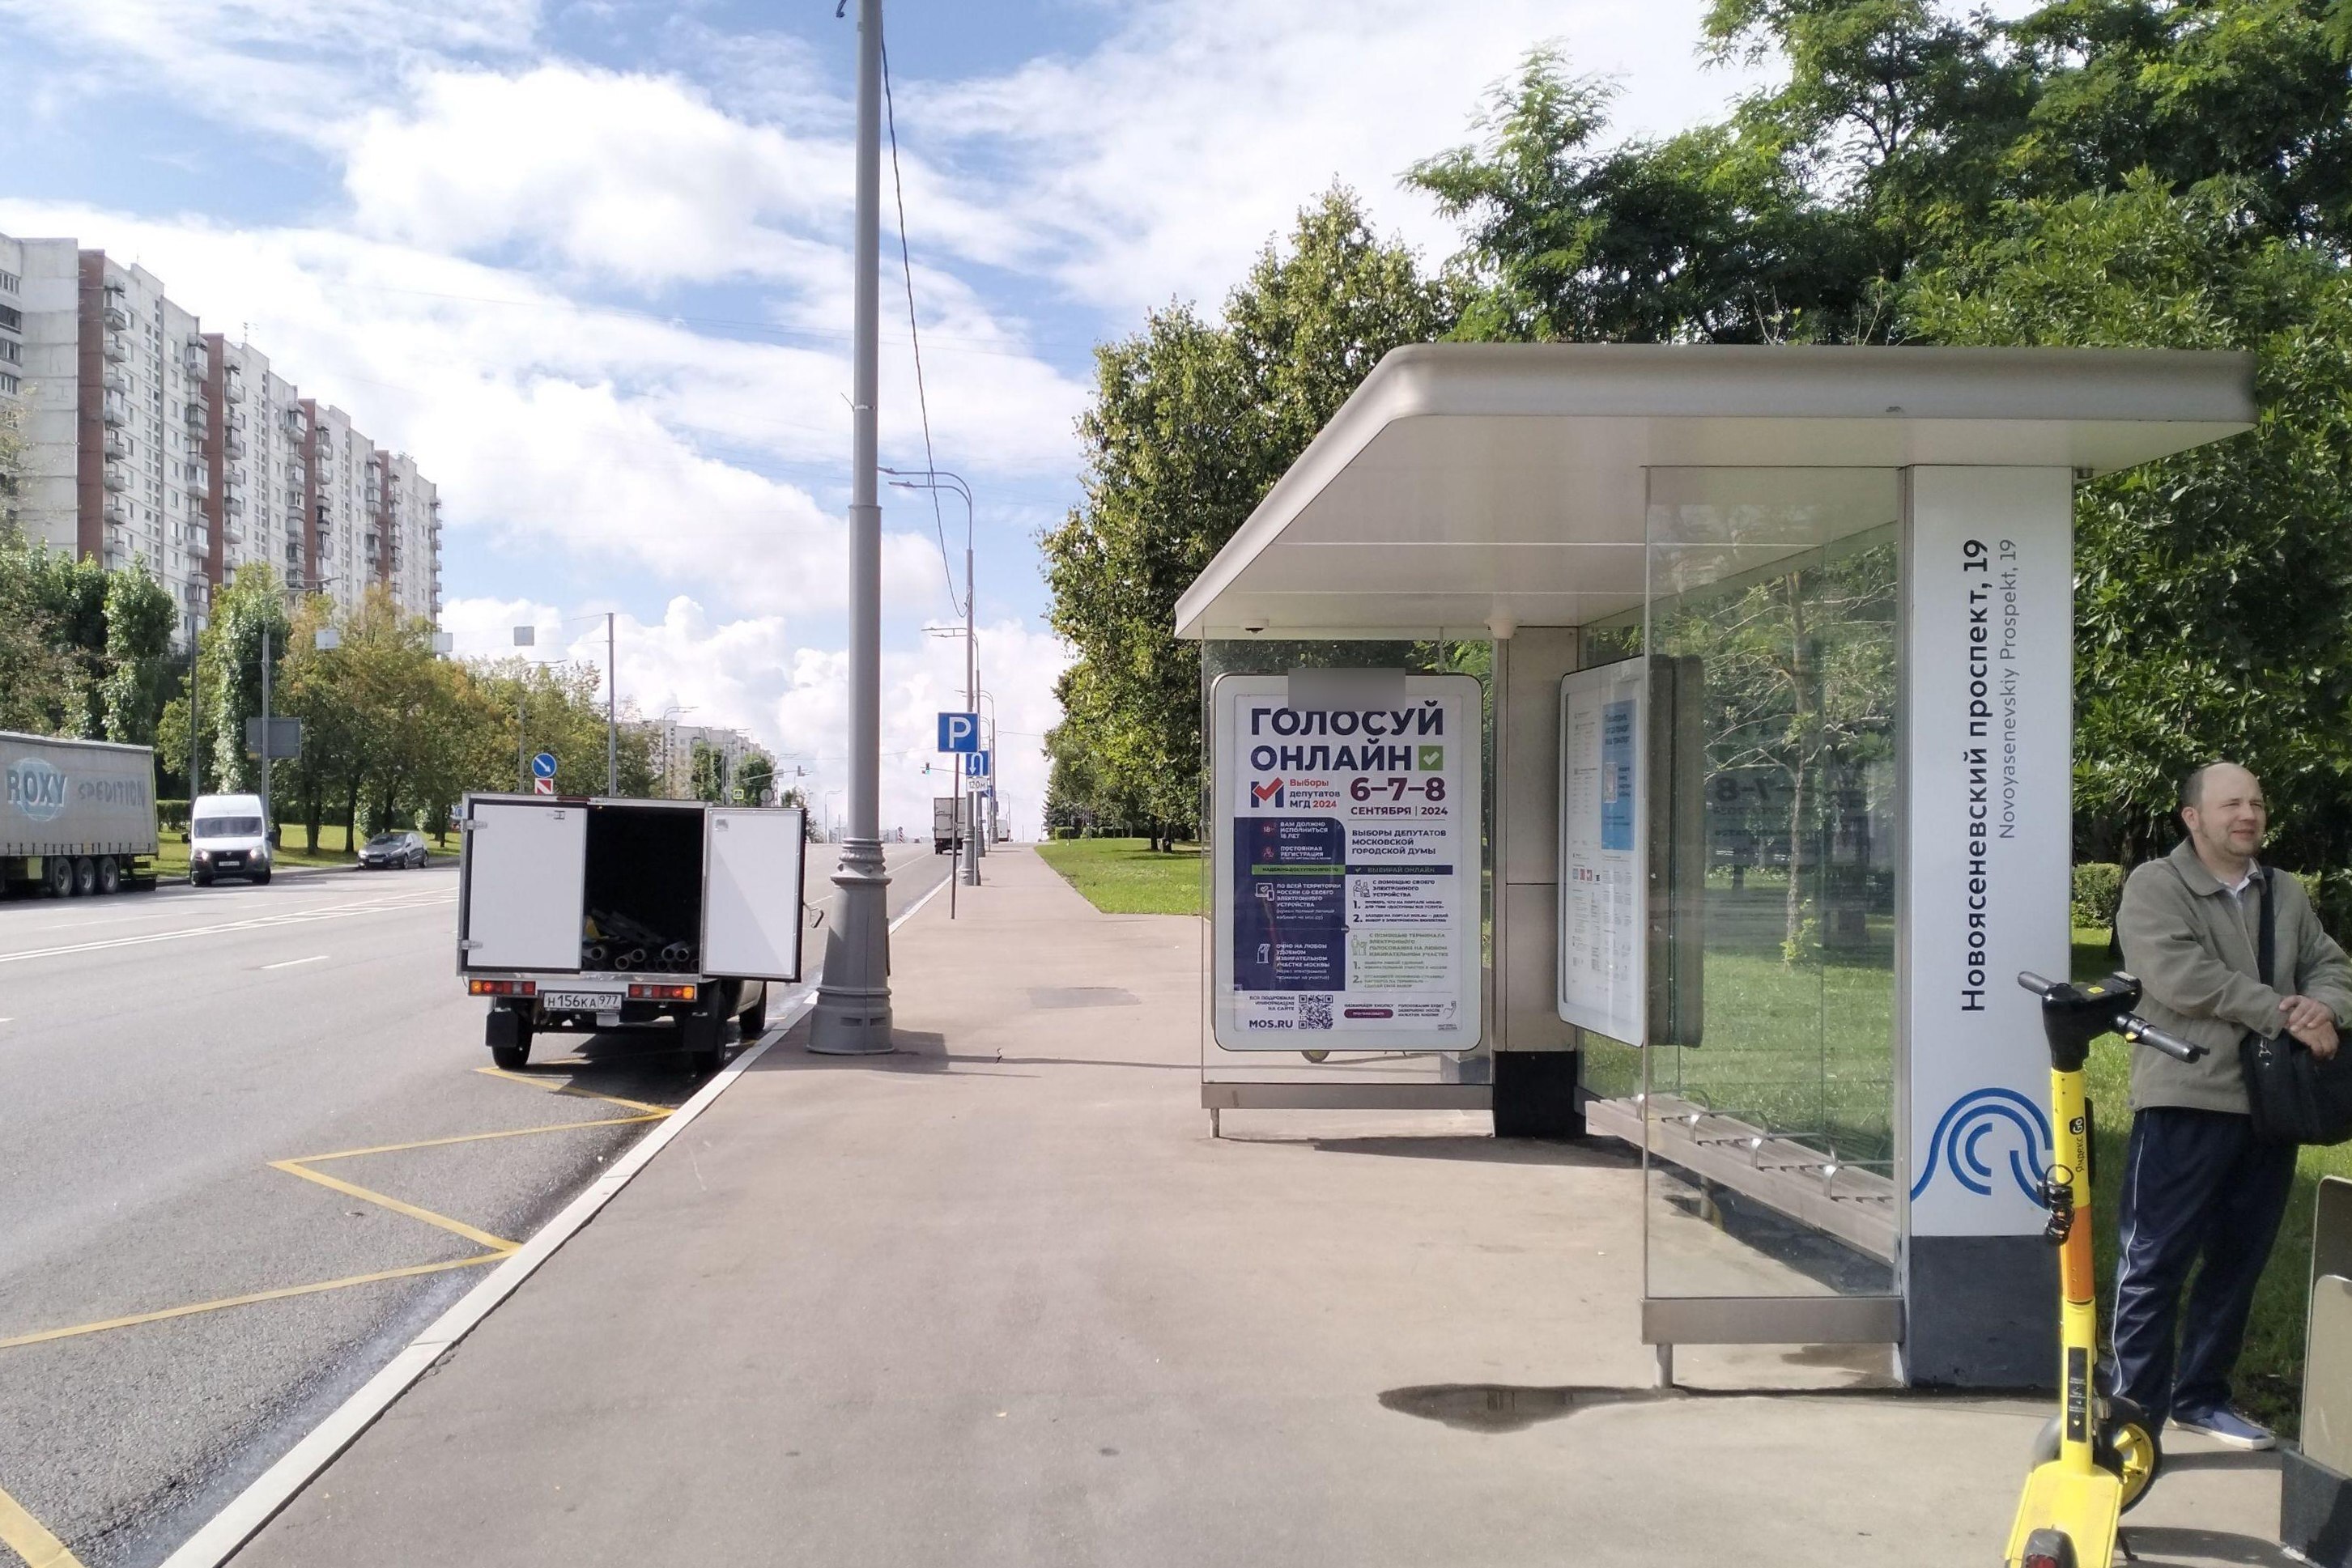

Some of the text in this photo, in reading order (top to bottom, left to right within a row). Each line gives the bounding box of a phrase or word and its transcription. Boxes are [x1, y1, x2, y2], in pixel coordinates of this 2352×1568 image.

[1999, 539, 2019, 838] Novoyasenevskiy Prospekt, 19
[949, 717, 972, 748] P
[1252, 700, 1444, 736] ГОЛОСУЙ
[1251, 738, 1411, 771] ОНЛАЙН
[7, 771, 146, 808] ROXY SPEDITION
[1290, 779, 1329, 788] Выборы
[1962, 540, 1993, 1010] Новоясеневский проспект, 19
[1290, 801, 1311, 809] МГД
[1350, 807, 1448, 815] СЕНТЯБРЯ 2024
[1352, 847, 1406, 855] ГОРОДСКОЙ
[599, 995, 618, 1004] 977
[1249, 1020, 1293, 1028] MOS.RU
[2073, 1119, 2085, 1173] Яндекс Go
